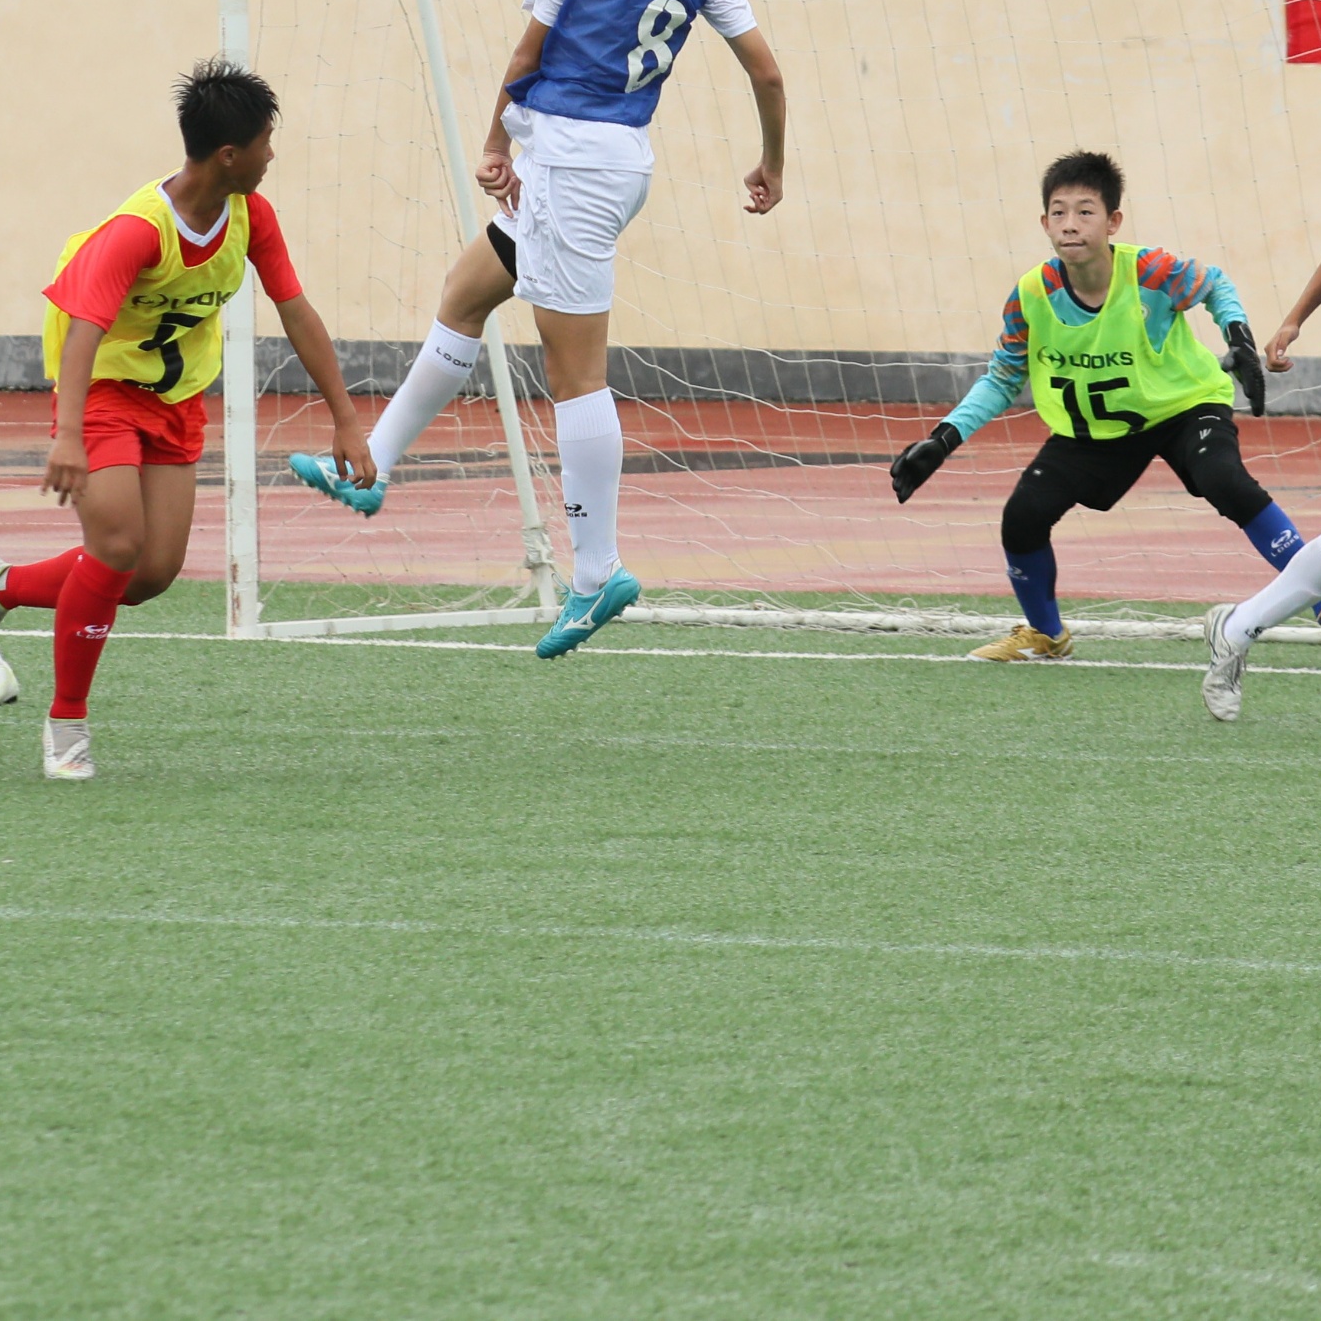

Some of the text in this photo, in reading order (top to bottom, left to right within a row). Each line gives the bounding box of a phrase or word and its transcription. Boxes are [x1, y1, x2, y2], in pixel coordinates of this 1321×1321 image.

[121, 312, 206, 395] 5
[1069, 351, 1134, 370] LOOKS
[1050, 376, 1149, 439] 15
